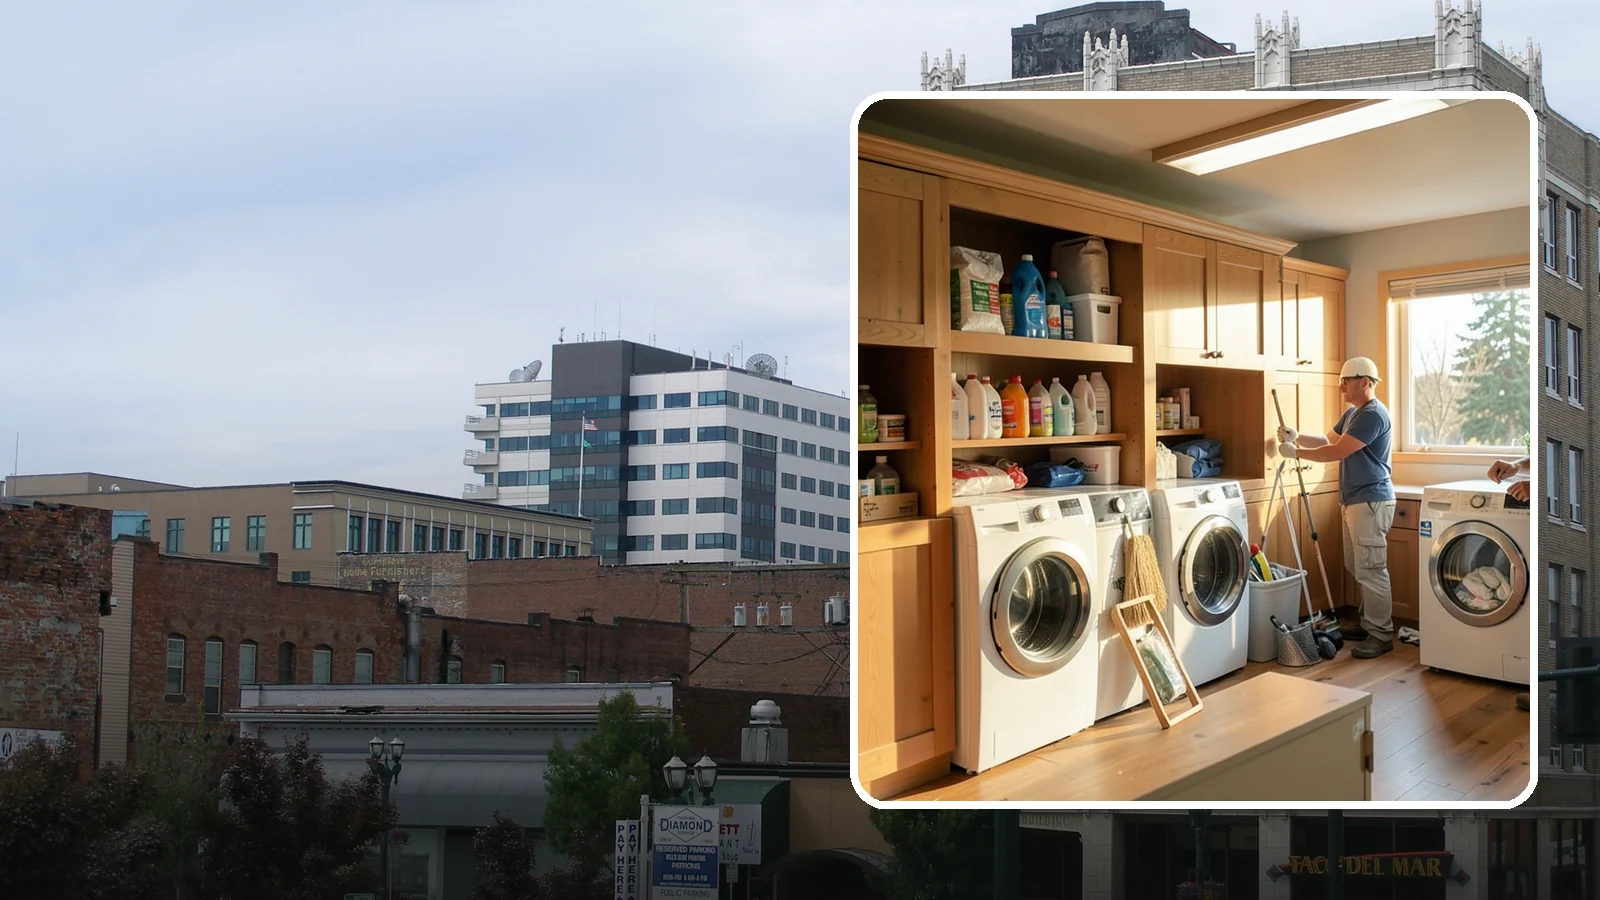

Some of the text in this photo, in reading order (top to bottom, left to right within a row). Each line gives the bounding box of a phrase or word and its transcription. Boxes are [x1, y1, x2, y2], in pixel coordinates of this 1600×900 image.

[370, 566, 427, 577] Furnishers
[660, 818, 713, 833] DIAMOND
[1022, 815, 1070, 828] BUILDING
[656, 845, 716, 854] RESERVED PARKING
[617, 825, 625, 893] PAY HERE
[628, 825, 636, 893] PAY HERE
[722, 851, 738, 862] Soup
[671, 862, 701, 870] PATRONS
[1289, 855, 1442, 877] TAC DEL MAR
[660, 888, 710, 898] PUBLIC PARKING
